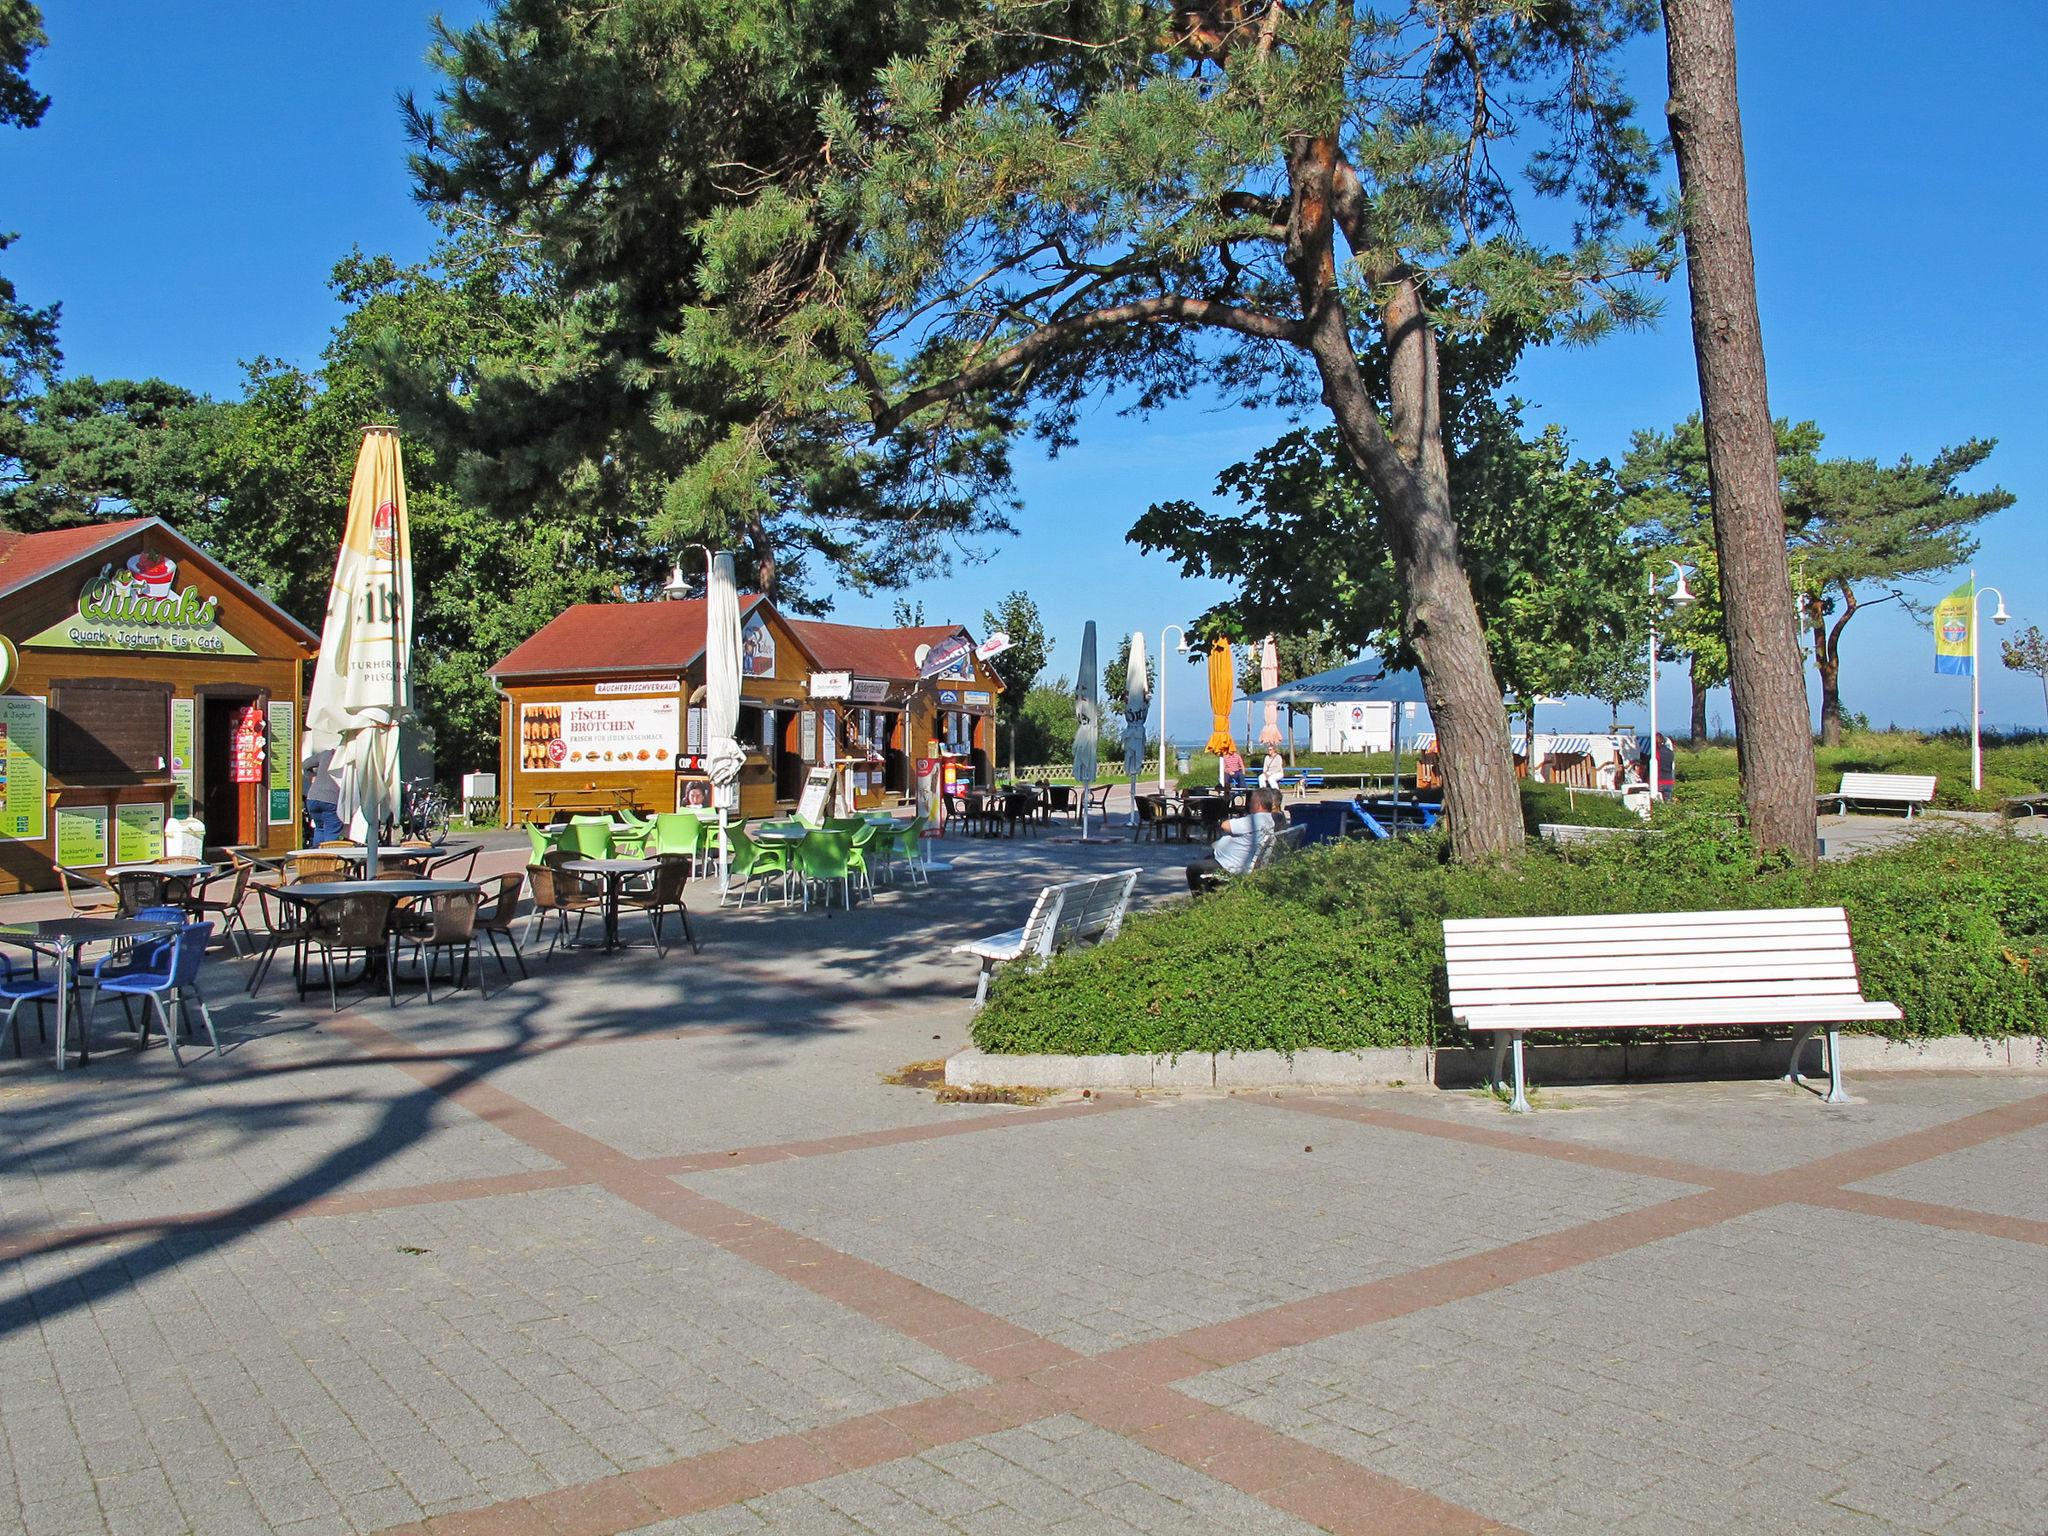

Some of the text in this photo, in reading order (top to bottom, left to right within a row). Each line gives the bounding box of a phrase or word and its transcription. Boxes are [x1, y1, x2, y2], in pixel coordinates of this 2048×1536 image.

[69, 628, 106, 641] Quark
[117, 631, 160, 648] Joghurt
[171, 634, 187, 646] Eis
